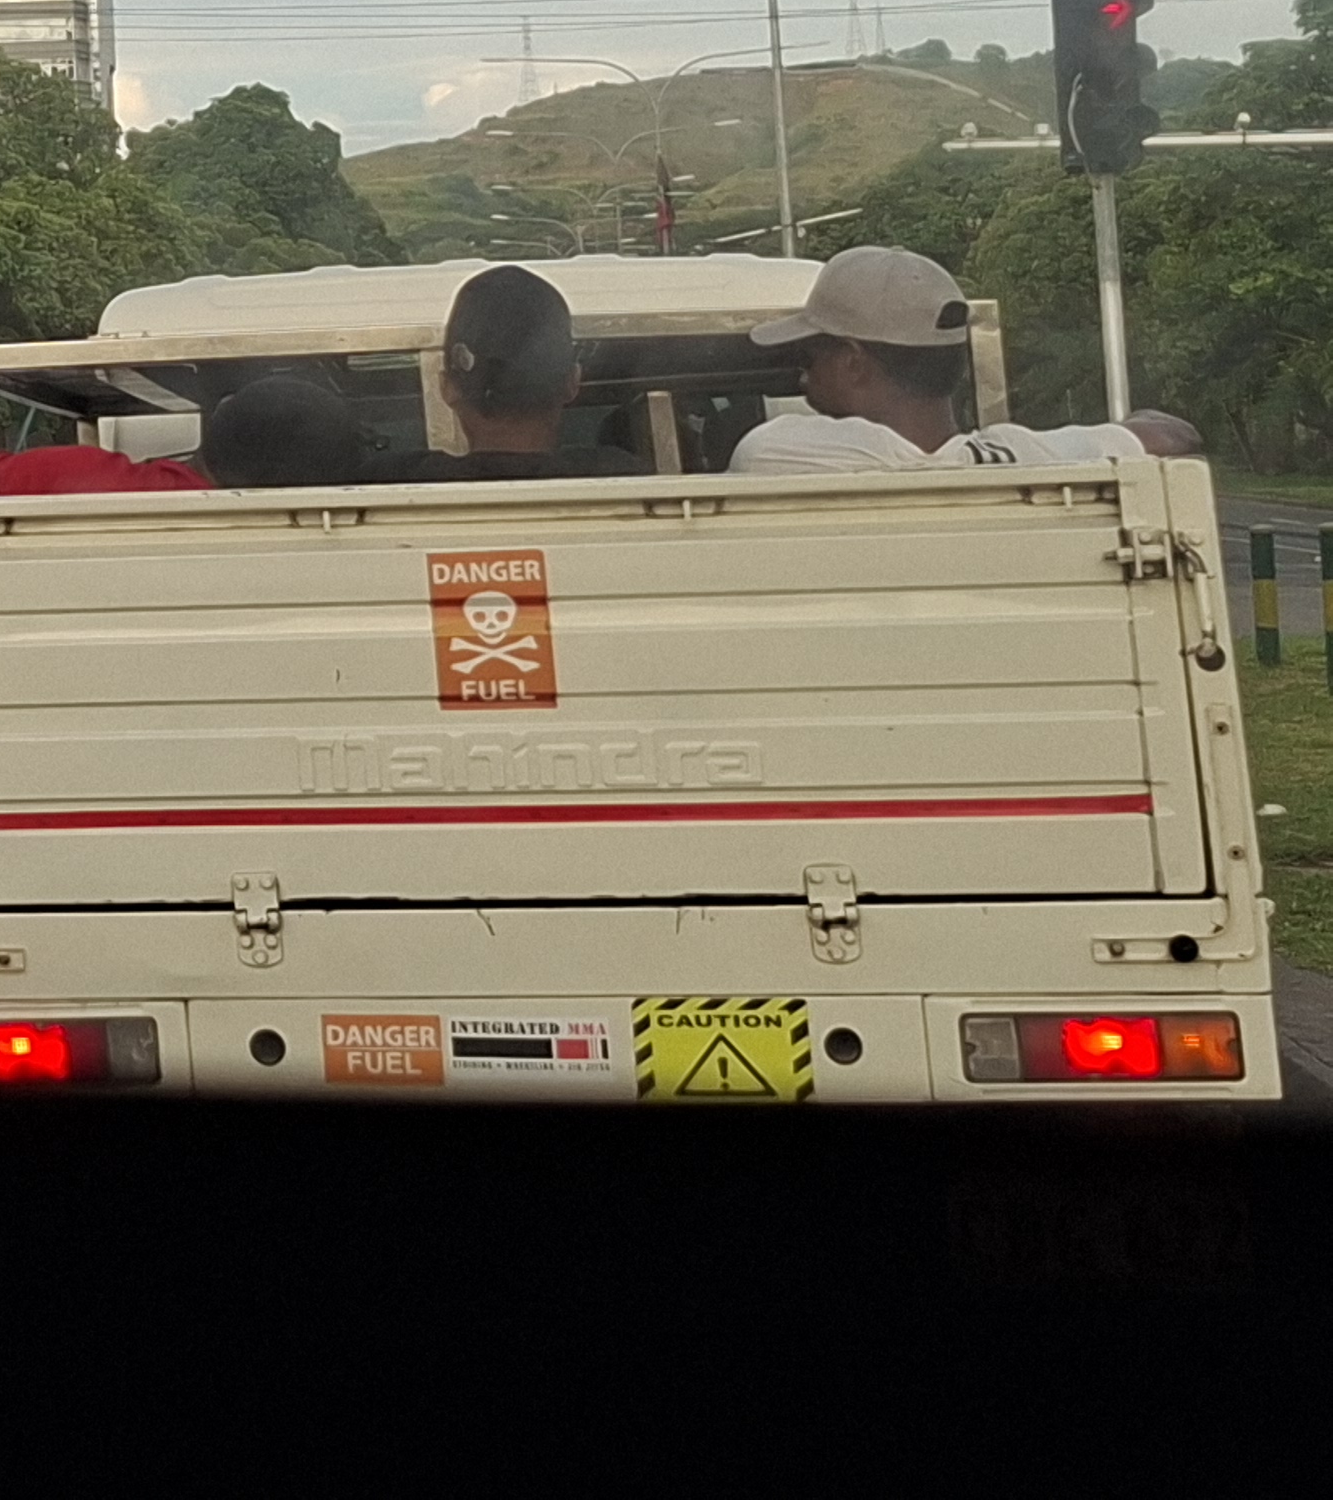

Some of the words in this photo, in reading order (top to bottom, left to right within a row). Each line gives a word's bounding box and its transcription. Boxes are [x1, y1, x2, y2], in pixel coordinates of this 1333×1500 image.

[432, 560, 541, 584] DANGER
[461, 679, 536, 701] FUEL
[451, 1020, 560, 1035] INTEGRATED
[567, 1022, 607, 1035] MMA
[656, 1014, 783, 1028] CAUTION
[326, 1025, 437, 1047] DANGER
[346, 1051, 423, 1075] FUEL
